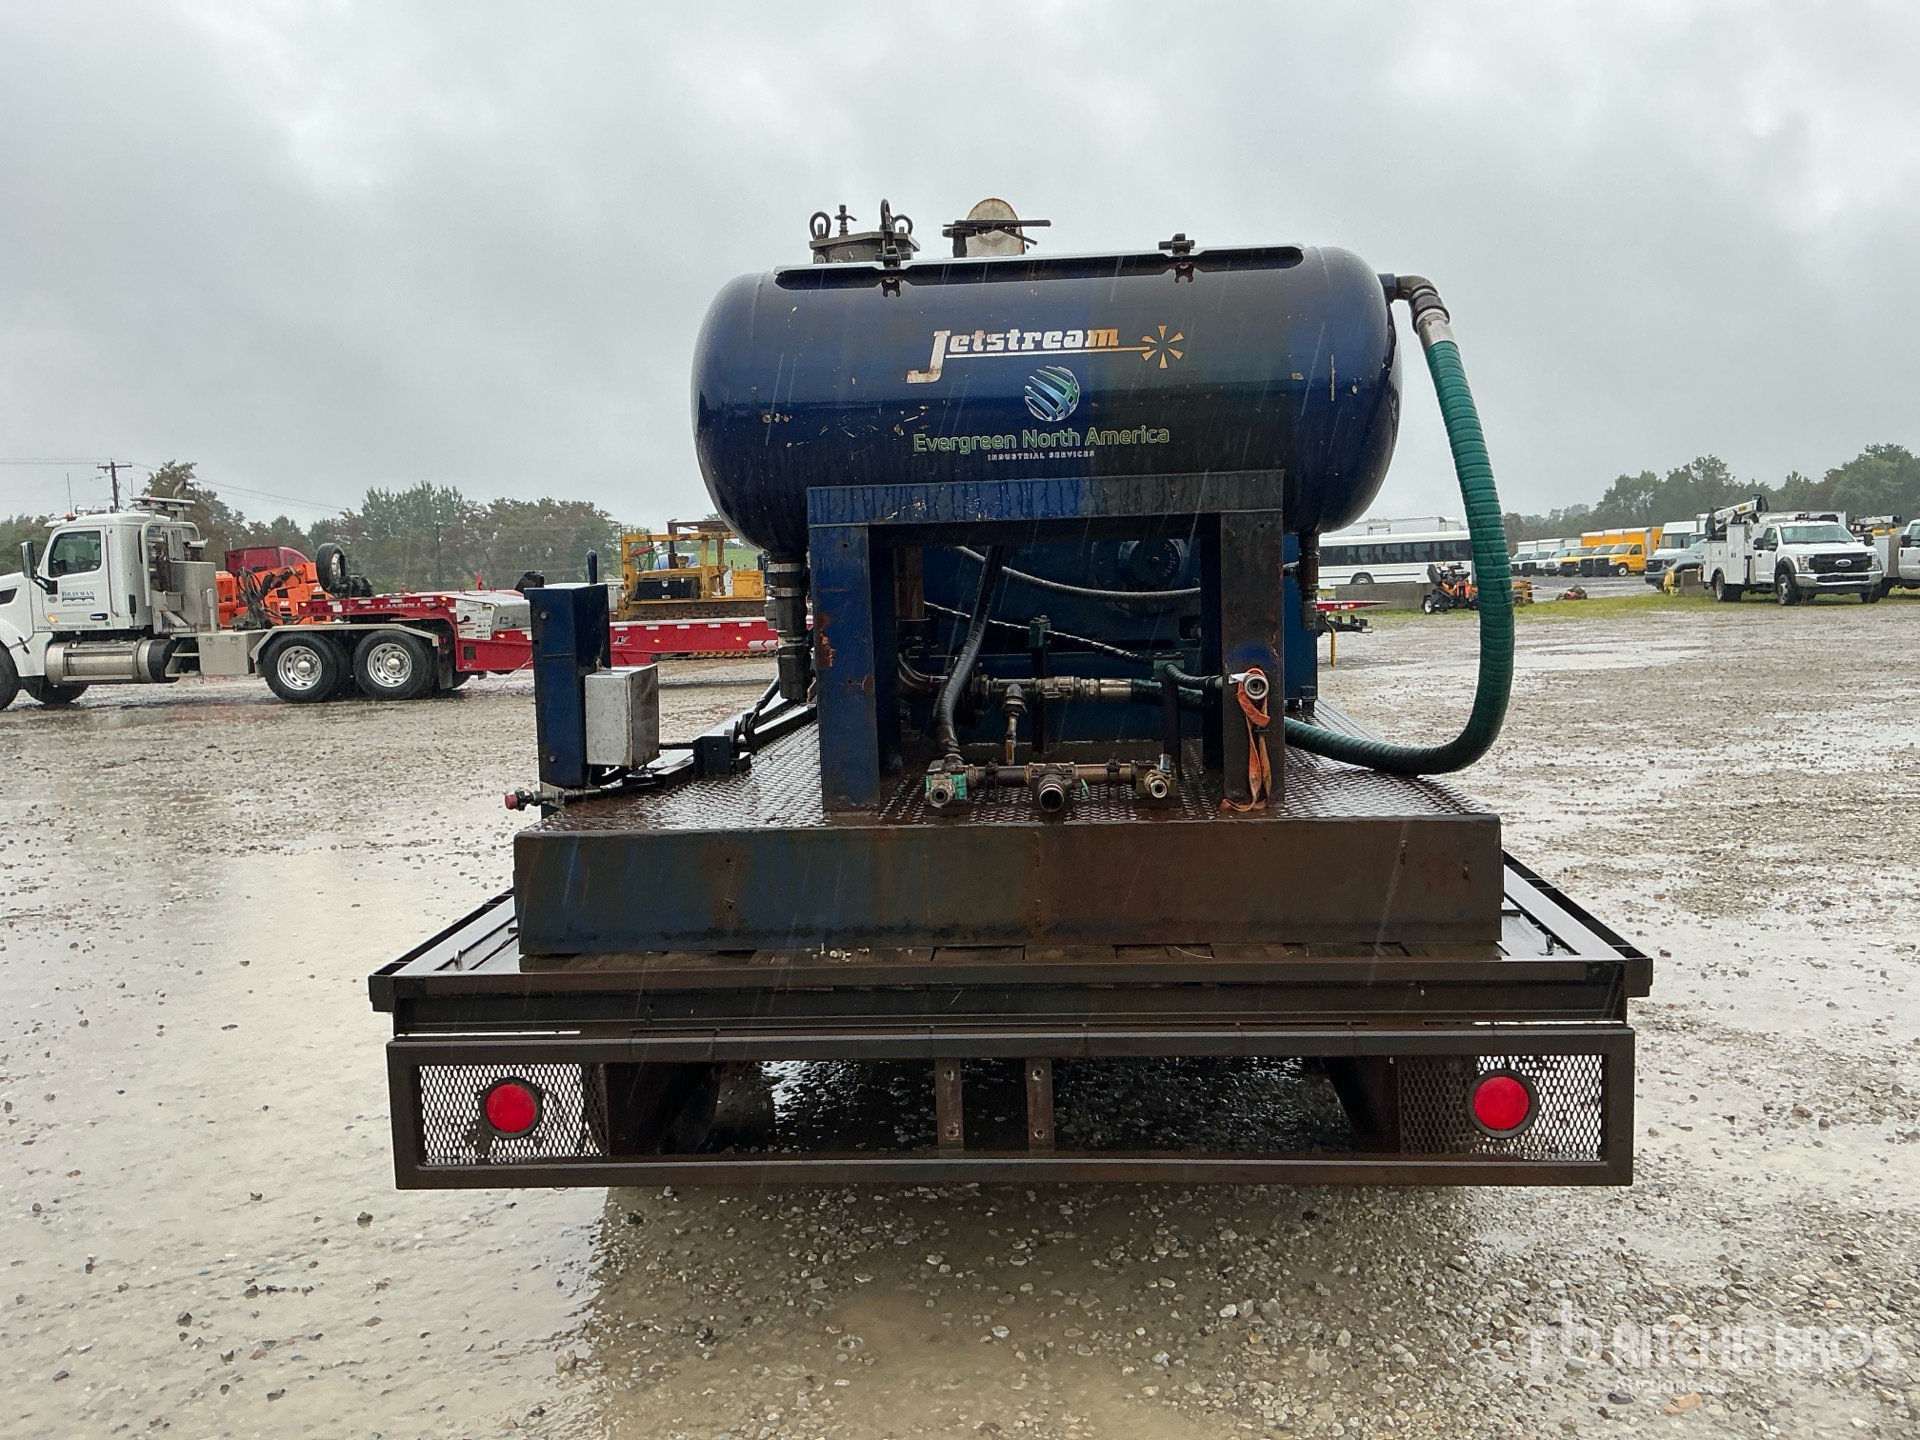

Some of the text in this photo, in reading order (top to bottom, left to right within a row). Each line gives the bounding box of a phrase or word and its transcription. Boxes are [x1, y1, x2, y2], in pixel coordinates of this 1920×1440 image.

[906, 328, 1119, 384] Jetstream
[913, 425, 1170, 454] Evergreen North America
[987, 450, 1095, 461] INDUSTRIAL SERVICES
